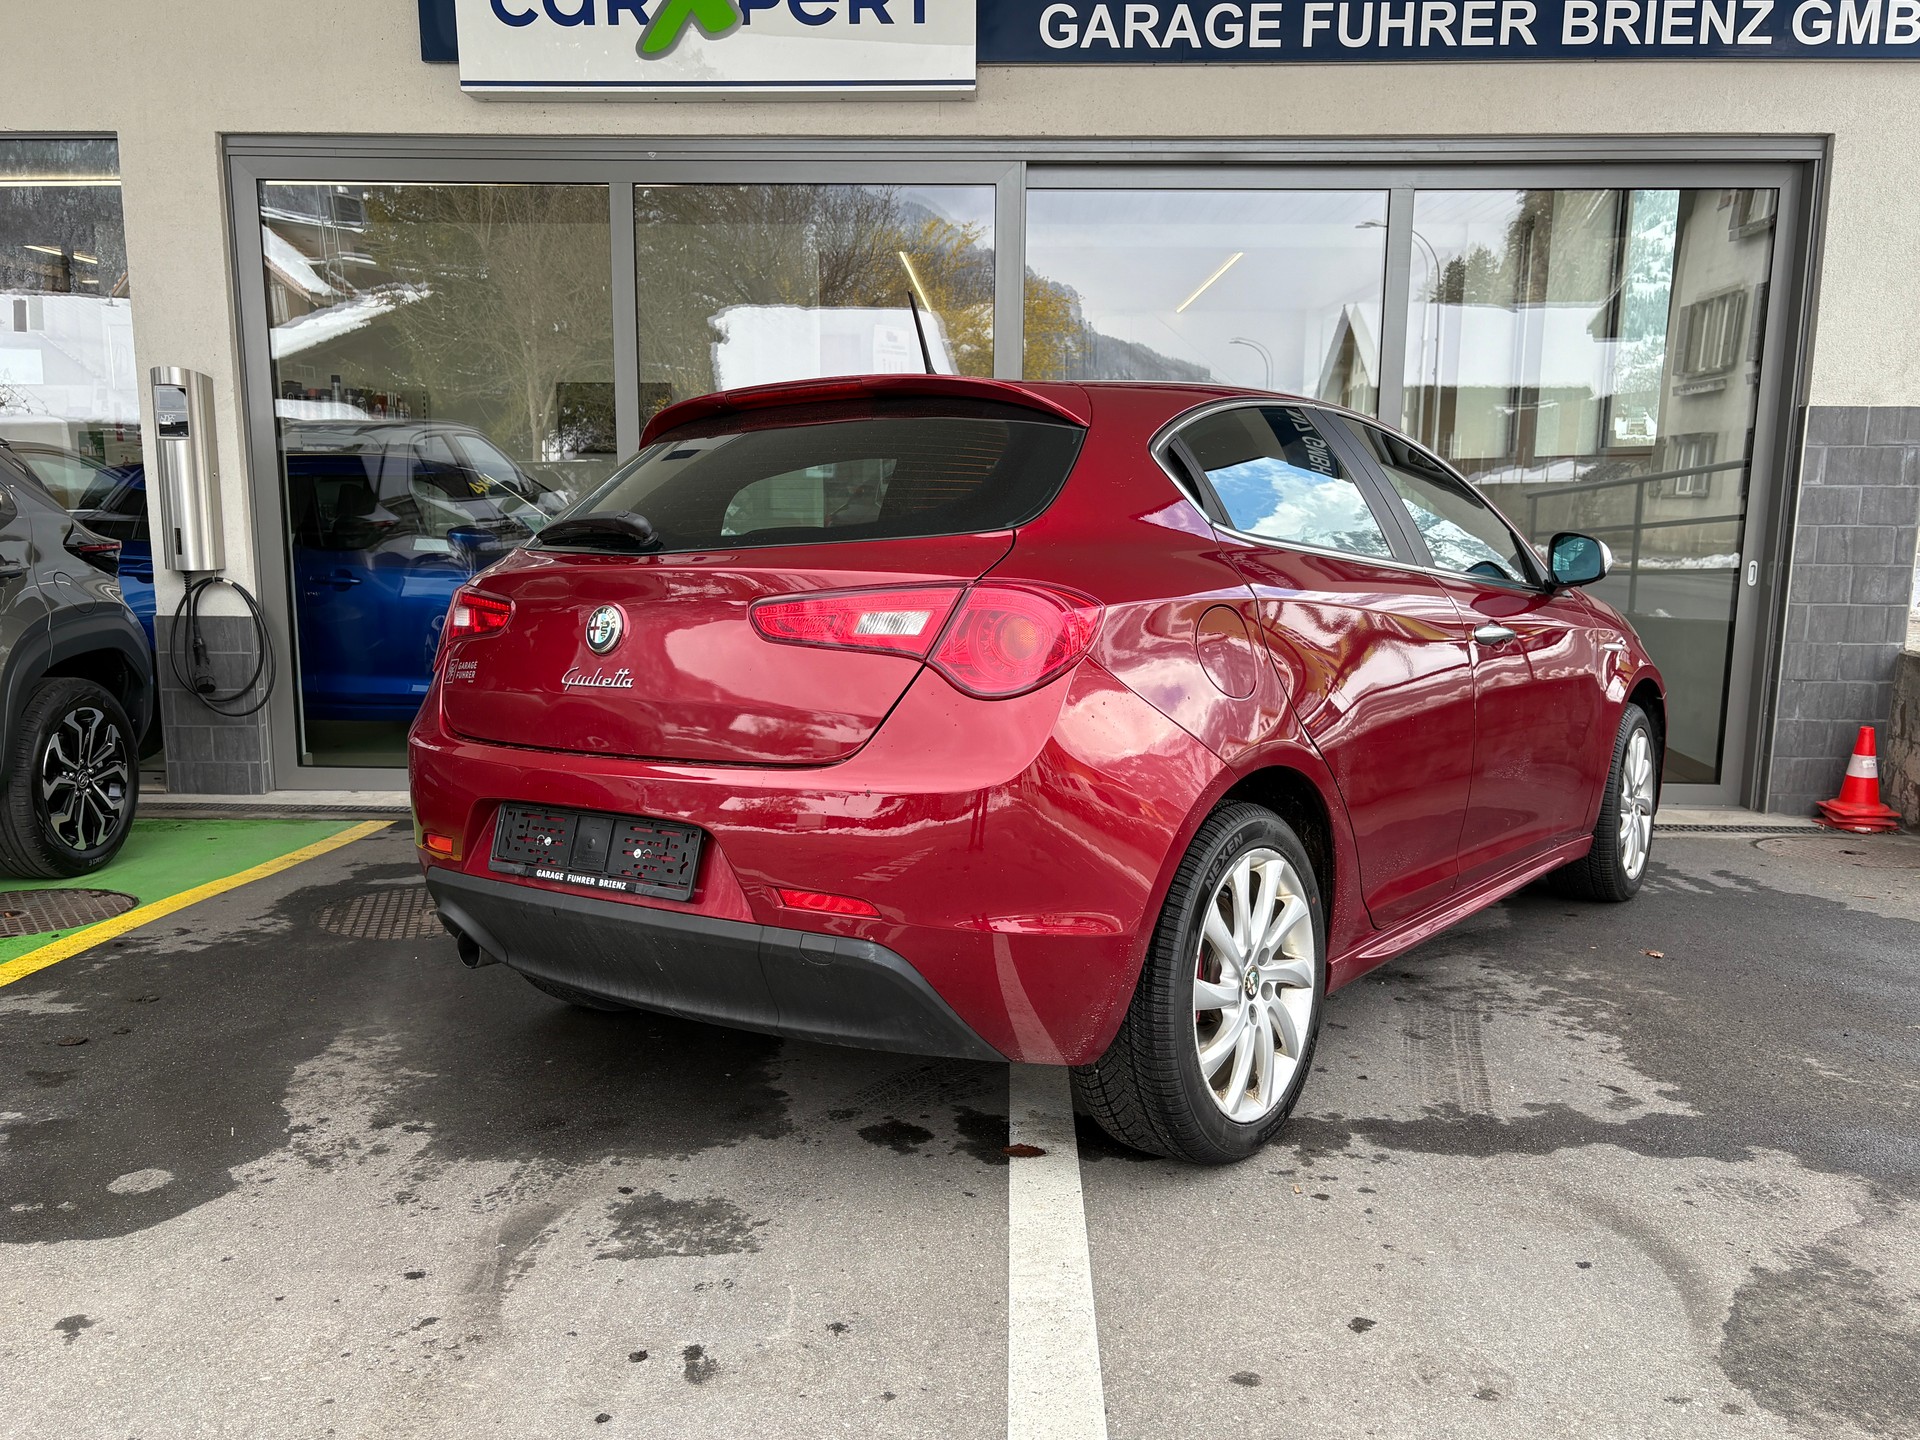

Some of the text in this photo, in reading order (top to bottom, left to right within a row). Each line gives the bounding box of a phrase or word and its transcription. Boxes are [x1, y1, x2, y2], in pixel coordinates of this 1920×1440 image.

[1039, 3, 1282, 49] GARAGE
[1302, 1, 1538, 48] FUHRER
[1561, 0, 1774, 45] BRIENZ
[455, 670, 476, 679] FUHRER
[457, 660, 478, 670] GARAGE
[561, 666, 635, 691] Giulietta
[1205, 833, 1244, 891] NEXEN
[536, 869, 627, 890] GARAGE FUHRER BRIENZ
